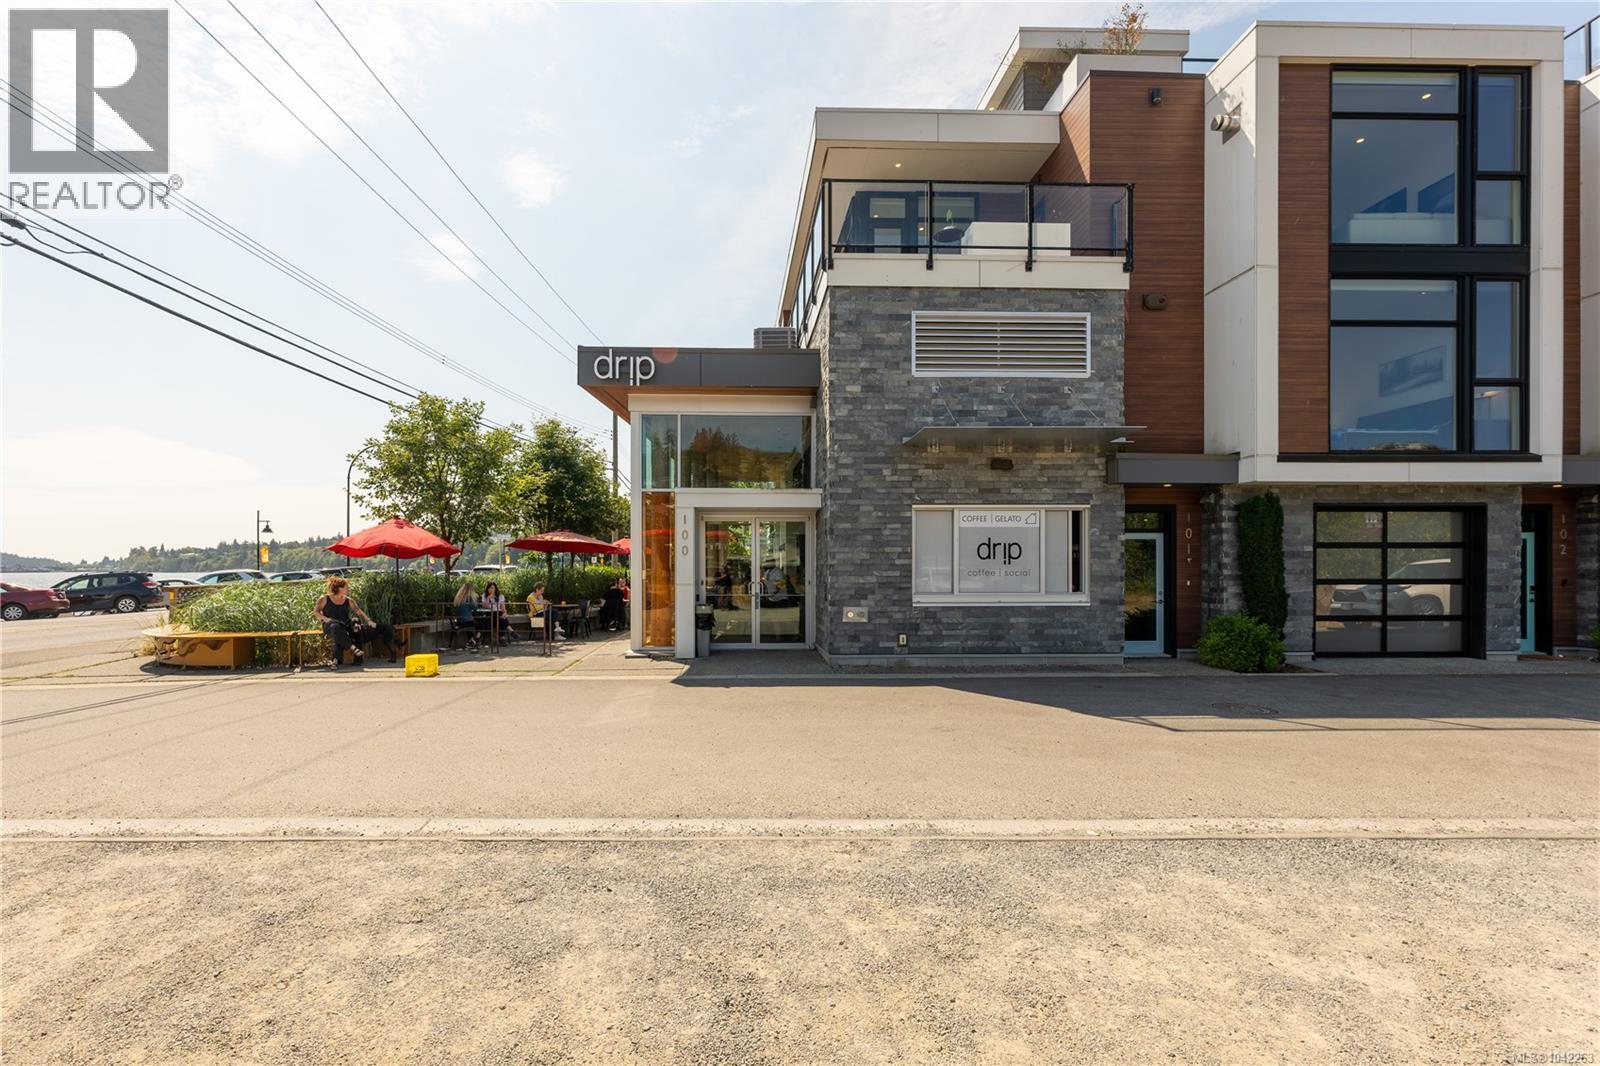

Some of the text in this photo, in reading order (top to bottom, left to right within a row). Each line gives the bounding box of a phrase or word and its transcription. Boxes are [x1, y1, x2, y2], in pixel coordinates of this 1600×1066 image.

[594, 348, 656, 387] drip
[681, 514, 689, 556] 100
[961, 515, 1022, 523] COFFEE GELATO
[1560, 513, 1568, 555] 102
[977, 536, 1022, 565] drip
[967, 568, 1031, 577] coffee social
